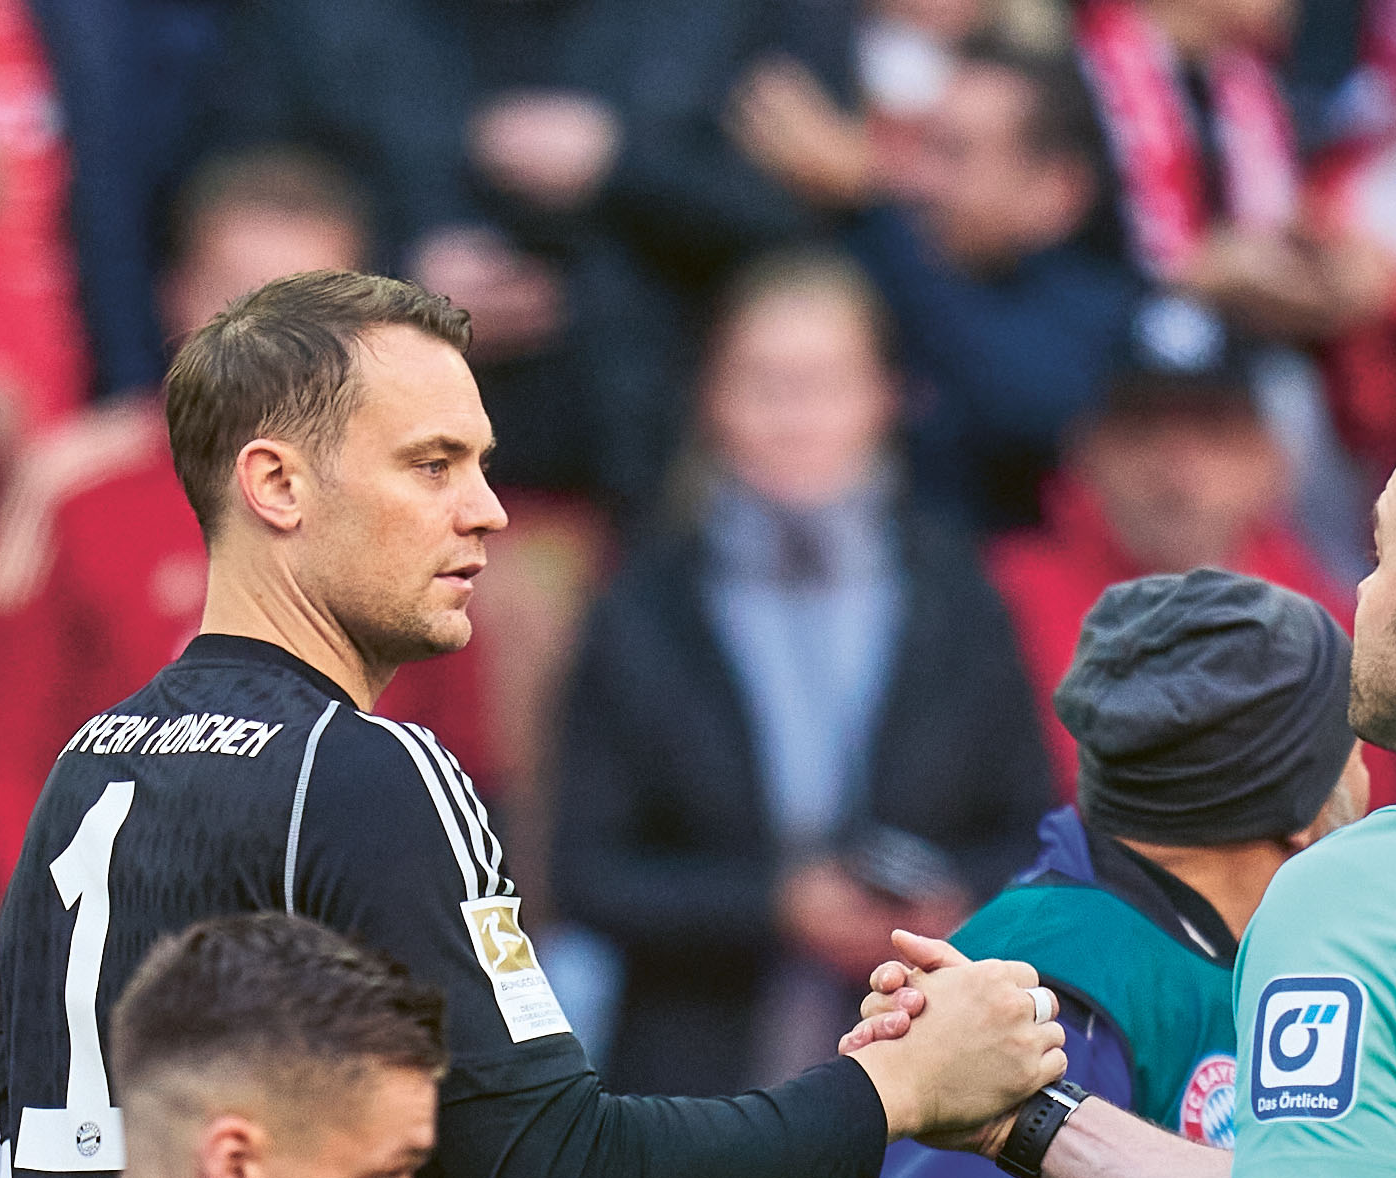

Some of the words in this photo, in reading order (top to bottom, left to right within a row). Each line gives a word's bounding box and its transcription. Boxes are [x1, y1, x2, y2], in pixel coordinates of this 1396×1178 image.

[15, 781, 136, 1171] 1
[1258, 1097, 1277, 1113] Das
[1279, 1090, 1339, 1110] Örtliche
